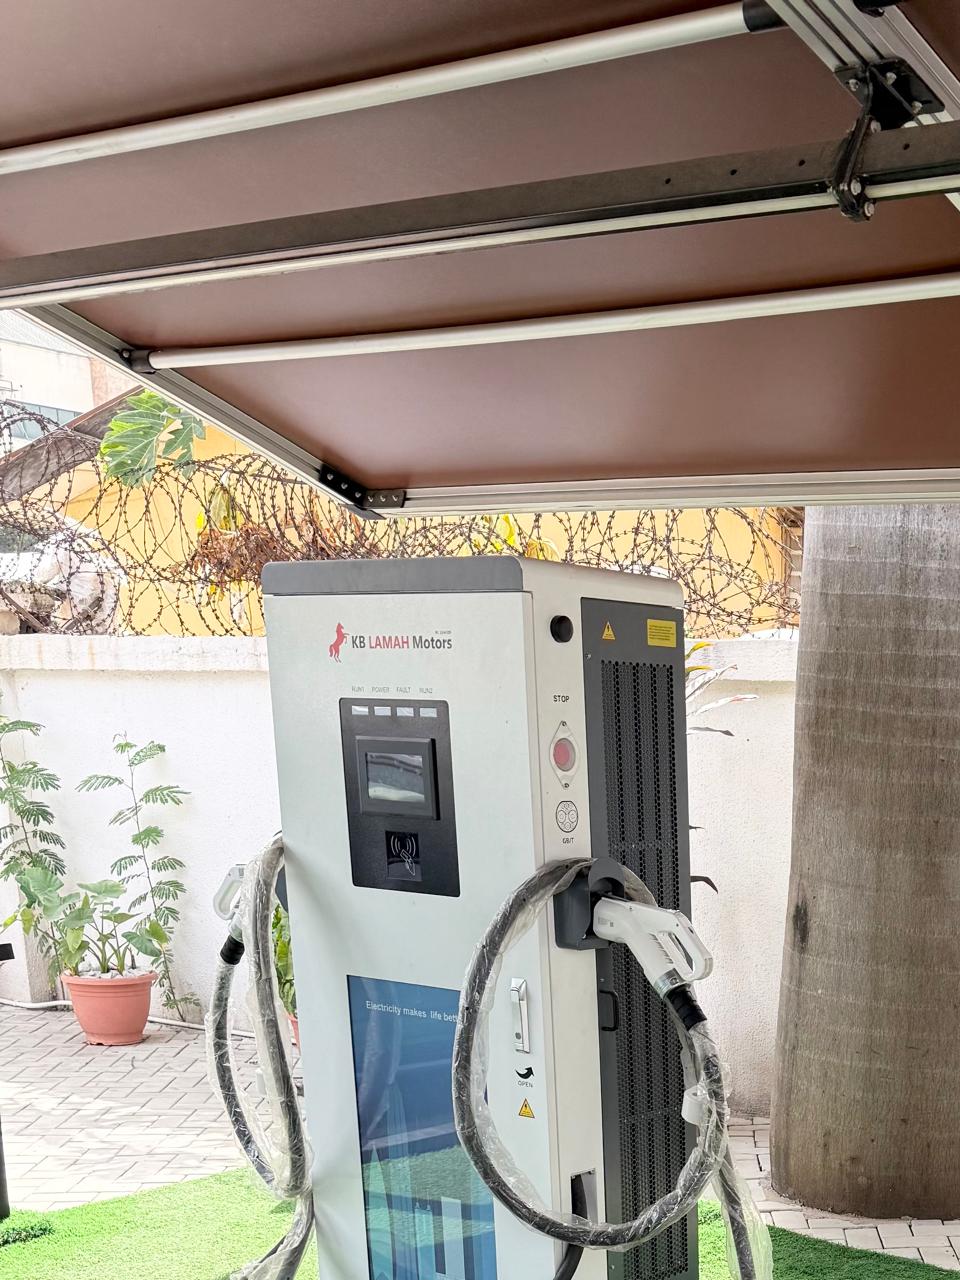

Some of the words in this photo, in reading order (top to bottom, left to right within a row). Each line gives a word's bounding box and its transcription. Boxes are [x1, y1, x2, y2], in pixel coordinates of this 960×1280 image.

[351, 635, 366, 649] KB
[368, 635, 410, 649] LAMAH
[412, 635, 453, 650] Motors
[371, 686, 390, 694] POWER
[396, 686, 412, 694] FAULT
[553, 694, 570, 703] STOP
[365, 1000, 402, 1016] Electricity
[402, 1007, 427, 1019] makes
[430, 1011, 442, 1020] life
[517, 1080, 533, 1088] OPEN
